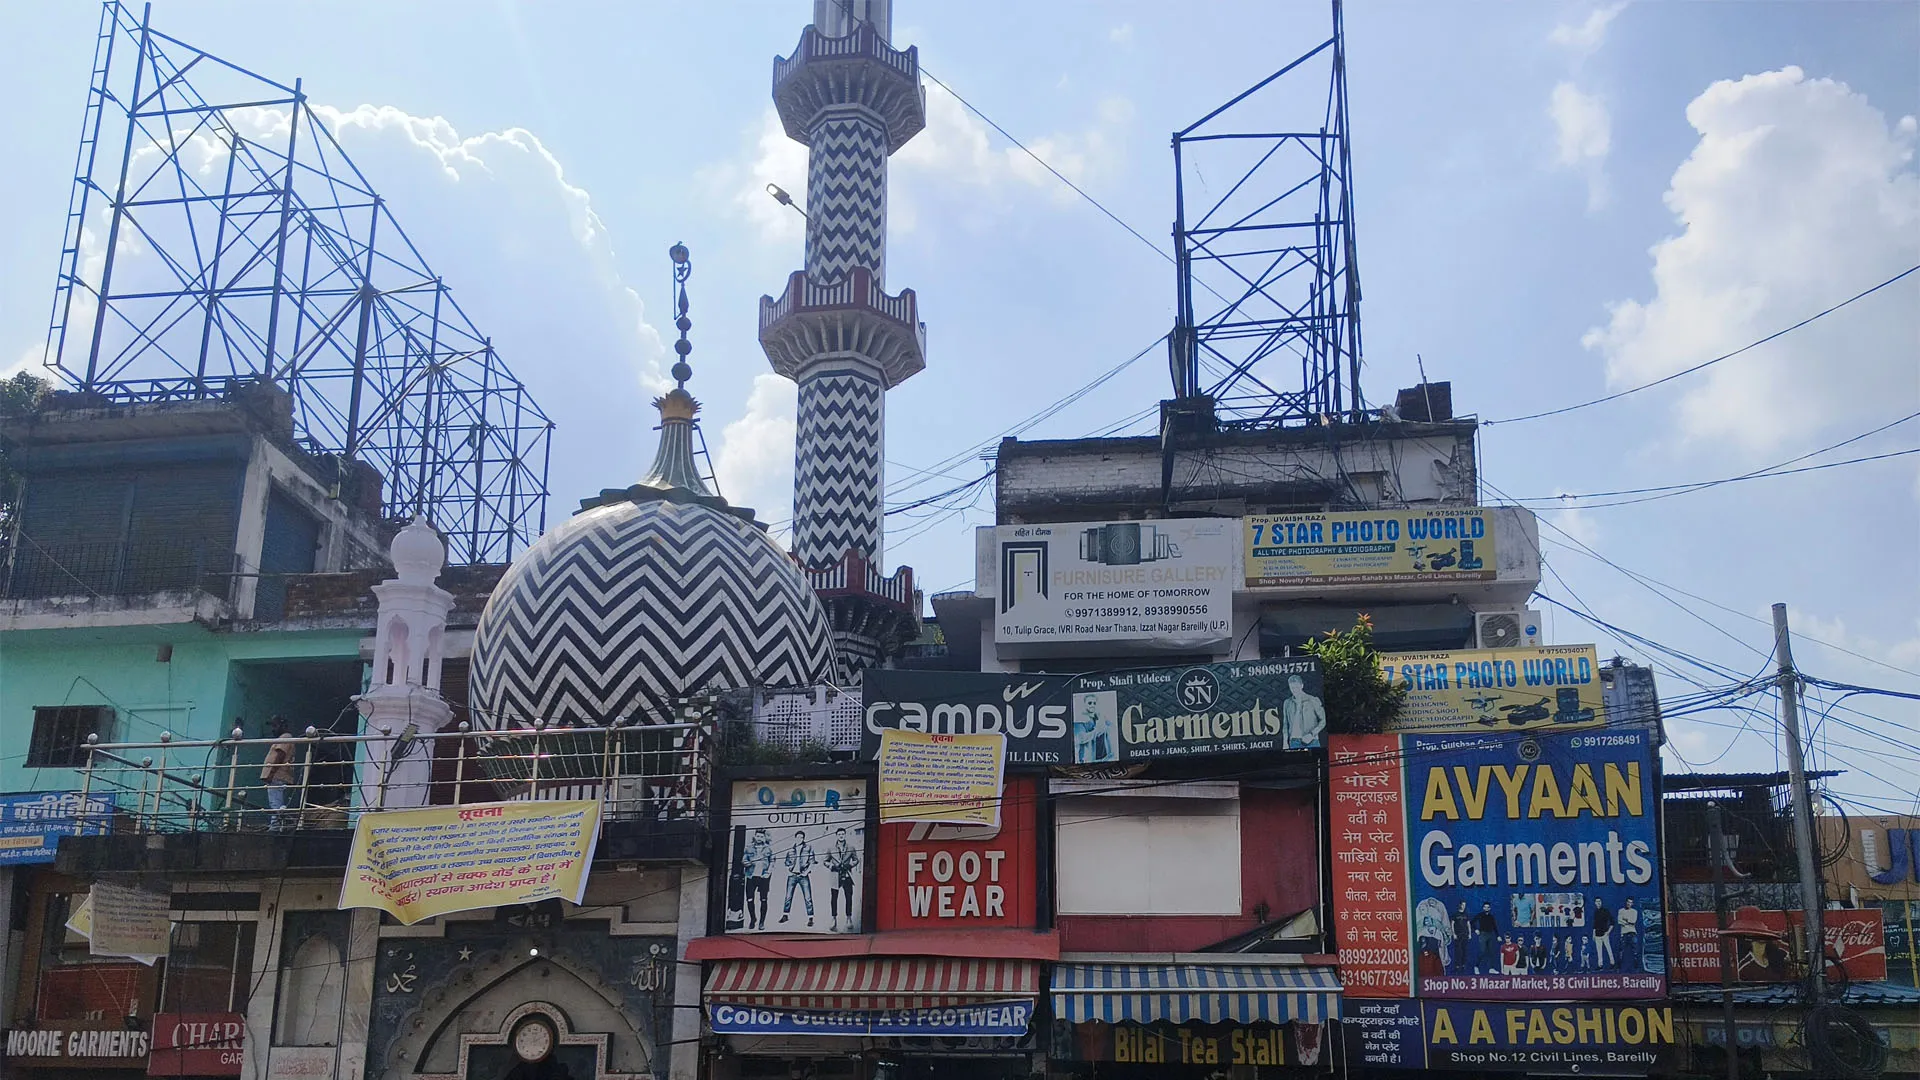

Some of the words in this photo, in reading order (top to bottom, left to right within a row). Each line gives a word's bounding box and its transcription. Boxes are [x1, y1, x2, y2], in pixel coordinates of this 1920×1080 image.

[1252, 516, 1269, 524] Prop.
[1252, 524, 1264, 546] 7
[1271, 522, 1323, 544] STAR
[1332, 519, 1400, 542] PHOTO
[1407, 517, 1484, 540] WORLD
[1288, 546, 1336, 554] PHOTOGRAPHY
[1053, 570, 1146, 586] FURNISURE
[1152, 566, 1228, 582] GALLERY
[1064, 592, 1084, 600] FOR
[1086, 592, 1104, 600] THE
[1107, 590, 1134, 599] HOME
[1137, 590, 1150, 598] OF
[1153, 588, 1210, 598] TOMORROW
[1075, 606, 1142, 618] 9971389912,
[1144, 604, 1208, 616] 8938990556
[1002, 626, 1013, 636] 10,
[1014, 625, 1033, 636] Tulip
[1034, 626, 1057, 635] Grace,
[1058, 625, 1073, 634] IVRI
[1075, 624, 1093, 633] Road
[1096, 624, 1112, 633] Near
[1140, 623, 1156, 632] Izzat
[1158, 622, 1179, 633] Nagar
[1180, 621, 1208, 633] Bareilly
[1210, 620, 1229, 632] (U.P.)
[1230, 667, 1244, 678] M.
[1248, 661, 1316, 676] 9808947571
[1401, 663, 1449, 691] STAR
[1455, 660, 1516, 689] PHOTO
[1524, 657, 1592, 686] WORLD
[1080, 678, 1106, 689] Prop.
[1109, 675, 1133, 686] Shafi
[1184, 686, 1212, 706] SN
[1122, 698, 1280, 744] Garments
[1166, 746, 1189, 755] JEANS,
[1191, 745, 1212, 754] SHIRT,
[1222, 743, 1248, 751] SHIRTS,
[1250, 740, 1273, 748] JACKET
[1584, 735, 1640, 746] 9917268491
[1024, 752, 1059, 762] LINES
[1342, 771, 1390, 788] मोहरें
[1420, 762, 1643, 820] AVYAAN
[458, 807, 504, 821] सूचना
[768, 812, 829, 824] OUTFIT
[1347, 810, 1367, 825] वर्दी
[1373, 810, 1387, 825] की
[1342, 828, 1362, 844] नेम
[1368, 828, 1393, 843] प्लेट
[1338, 848, 1378, 865] गाड़ियों
[1384, 847, 1400, 862] की
[1420, 830, 1652, 888] Garments
[908, 850, 1005, 883] FOOT
[1347, 871, 1369, 882] नम्बर
[1374, 867, 1393, 882] प्लेट
[390, 872, 441, 893] न्यायालयों
[441, 872, 453, 882] से
[456, 870, 488, 880] वक्फ
[492, 866, 515, 877] बोर्ड
[518, 864, 531, 874] के
[536, 862, 556, 871] पक्ष
[559, 860, 574, 869] में
[467, 880, 505, 892] आदेश
[509, 877, 538, 888] प्राप्त
[540, 873, 556, 884] है।
[908, 885, 1005, 918] WEAR
[1376, 888, 1396, 901] स्टील
[1340, 908, 1349, 920] के
[1347, 927, 1358, 942] की
[1363, 927, 1376, 941] नेम
[1380, 927, 1398, 942] प्लेट
[1680, 942, 1720, 953] PROUDL
[1339, 949, 1409, 965] 8899232003
[1340, 970, 1410, 986] 9319677394
[1424, 978, 1449, 993] Shop
[1451, 978, 1468, 990] No.
[1471, 978, 1477, 990] 3
[1479, 977, 1510, 990] Mazar
[1512, 977, 1550, 990] Market,
[1552, 977, 1565, 989] 58
[1567, 976, 1589, 989] Civil
[1623, 976, 1660, 992] Bareilly
[716, 1004, 783, 1026] Color
[916, 1006, 1026, 1027] FOOTWEAR
[1360, 1004, 1381, 1014] हमारे
[1432, 1008, 1458, 1044] A
[1469, 1010, 1496, 1044] A
[1506, 1008, 1674, 1044] FASHION
[172, 1022, 246, 1050] CHAR
[1389, 1030, 1400, 1039] की
[7, 1031, 61, 1057] NOORIE
[68, 1030, 148, 1057] GARMENTS
[1115, 1028, 1165, 1064] Bilal
[1177, 1028, 1220, 1065] Tea
[1231, 1028, 1284, 1065] Stall
[1365, 1042, 1379, 1050] नेम
[1382, 1042, 1400, 1051] प्लेट
[1451, 1052, 1485, 1064] Shop
[1490, 1052, 1526, 1062] No.12
[1530, 1052, 1559, 1062] Civil
[1563, 1052, 1602, 1063] Lines,
[1608, 1052, 1657, 1064] Bareilly
